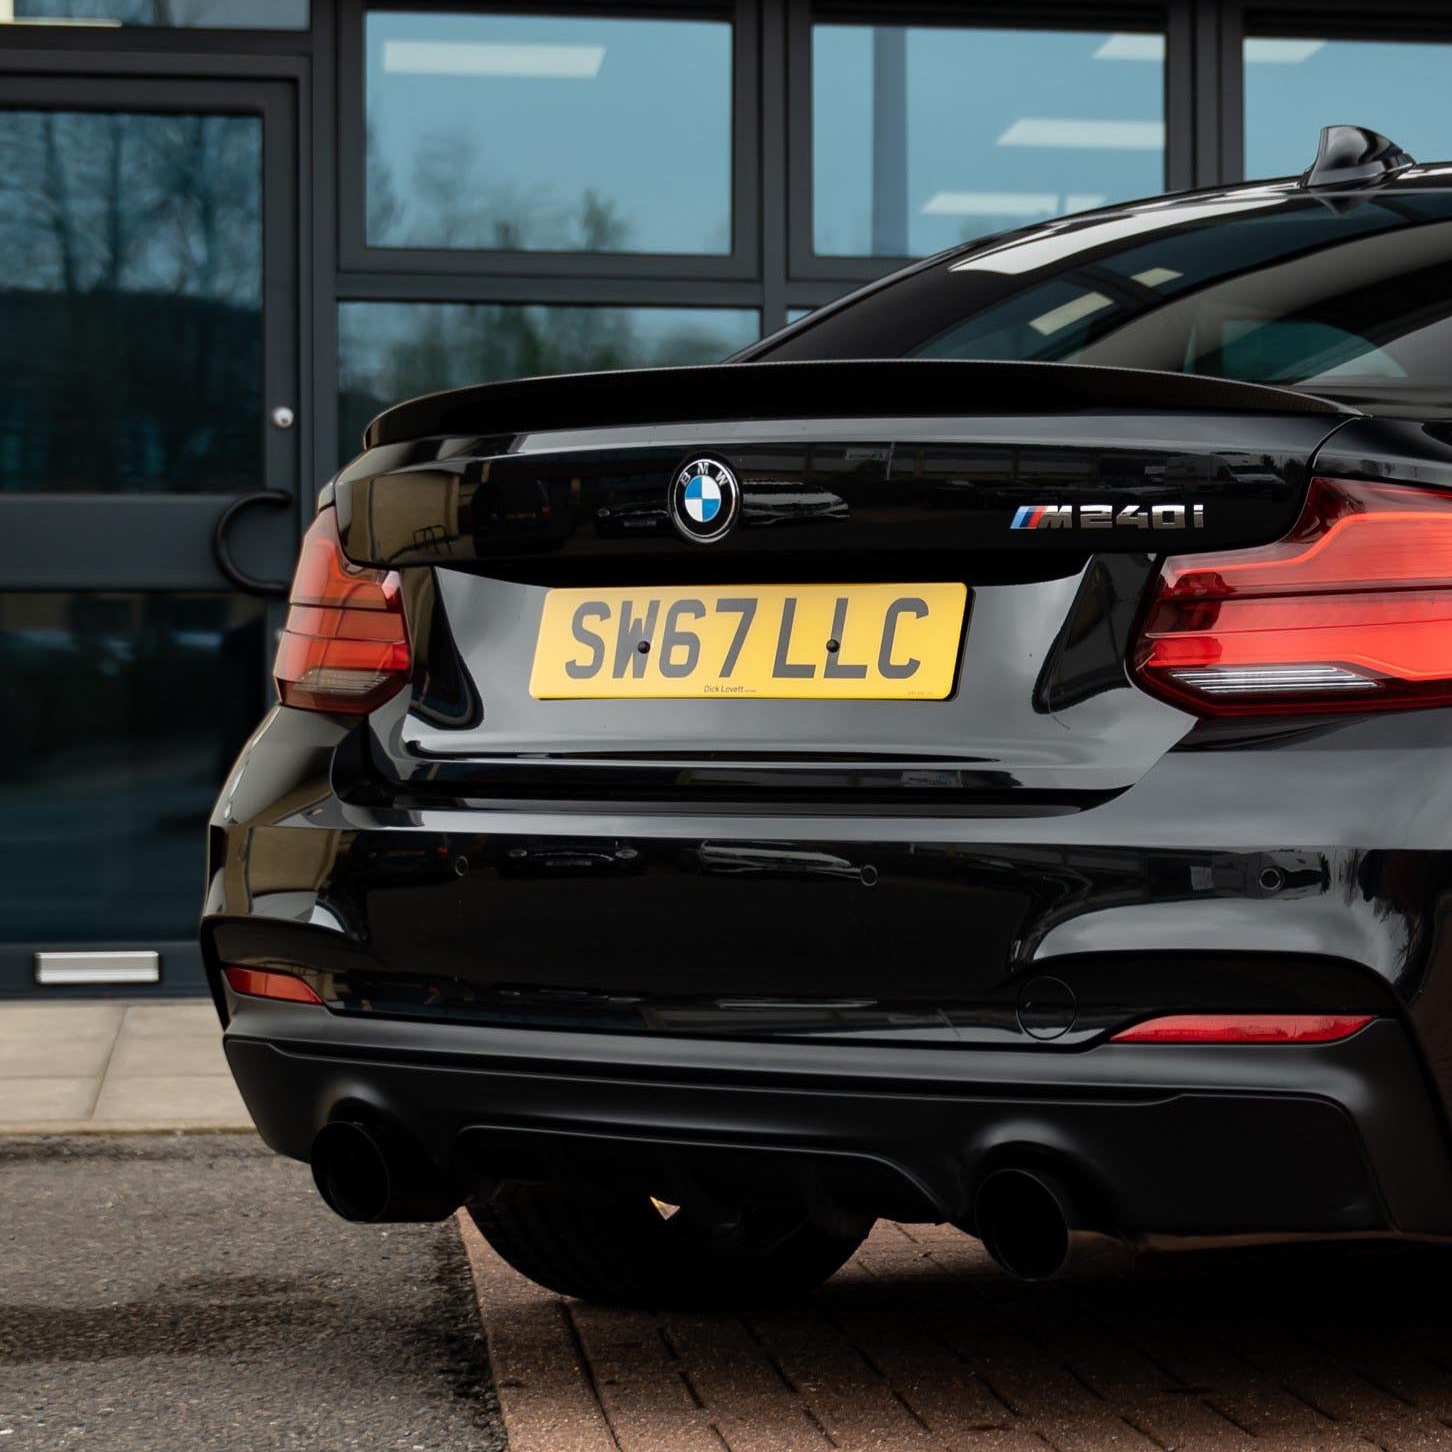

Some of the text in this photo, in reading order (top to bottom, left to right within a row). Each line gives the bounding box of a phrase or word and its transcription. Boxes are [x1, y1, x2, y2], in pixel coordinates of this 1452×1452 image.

[1037, 504, 1204, 529] M240i
[565, 598, 929, 679] SW67 LLC
[704, 685, 720, 693] Dick
[721, 685, 744, 693] Lovett
